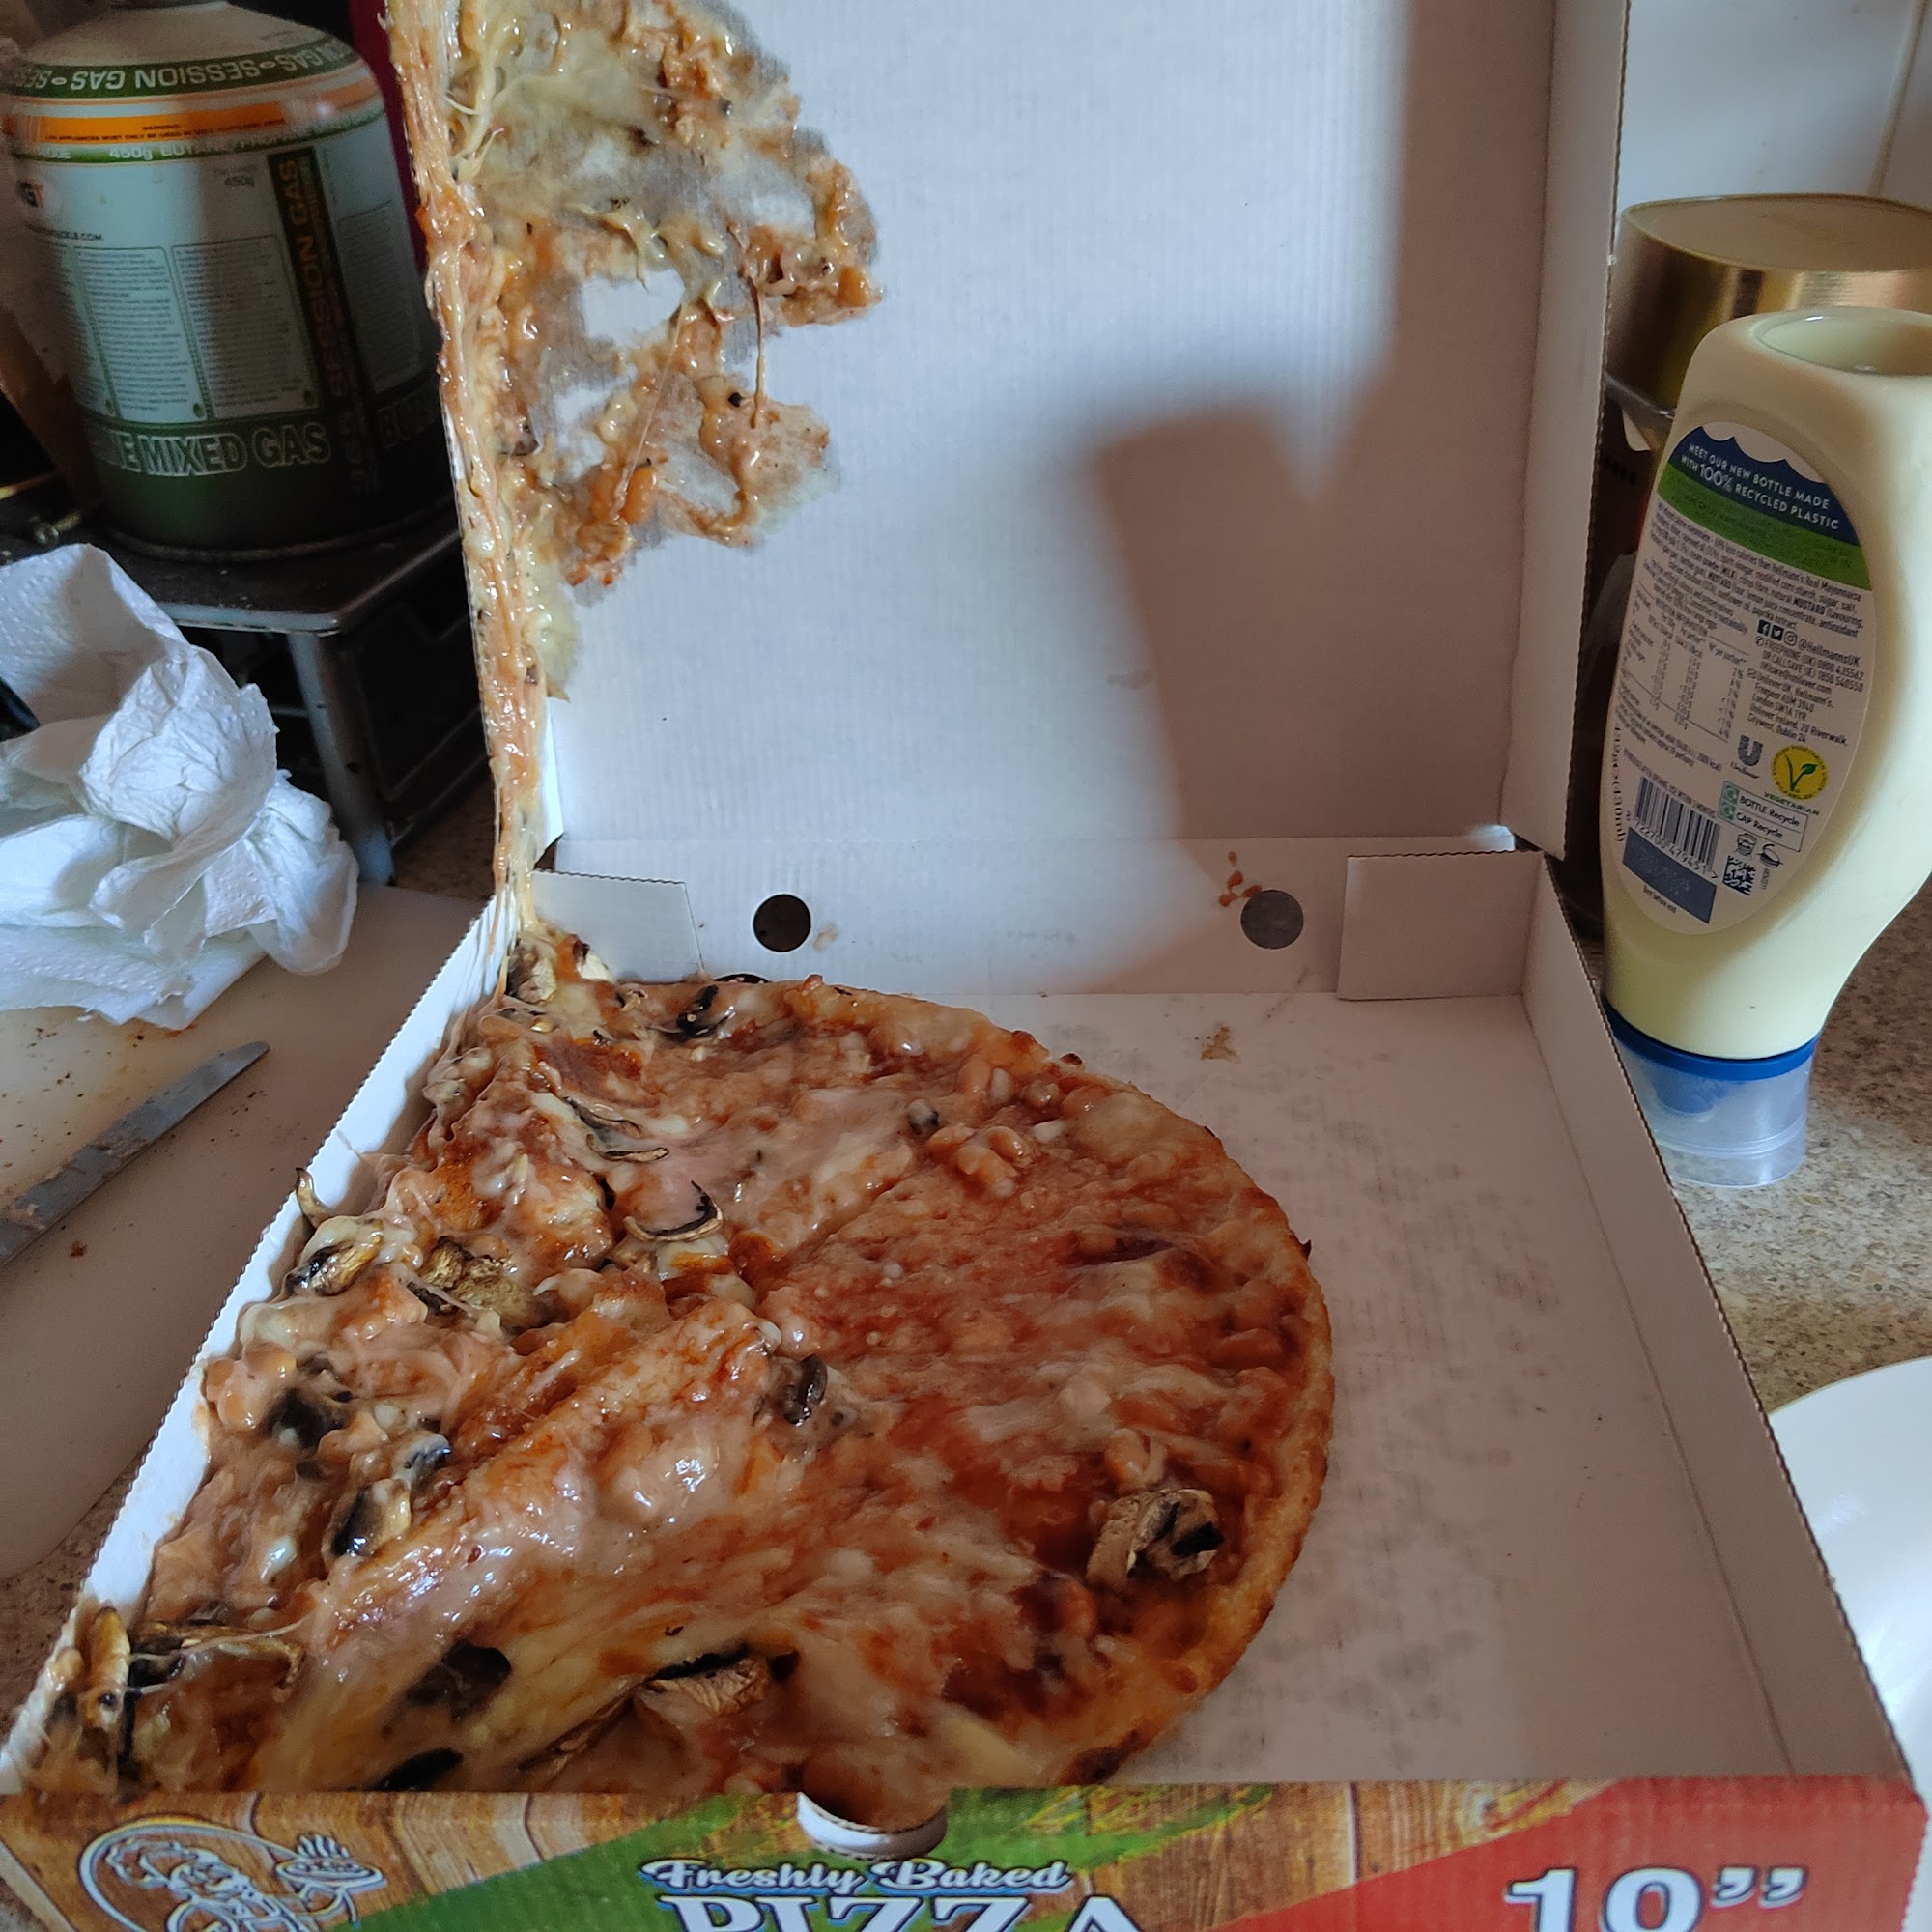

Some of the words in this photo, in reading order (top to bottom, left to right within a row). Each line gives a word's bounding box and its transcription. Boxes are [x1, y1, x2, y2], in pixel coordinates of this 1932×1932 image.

[70, 70, 126, 91] GAS
[134, 59, 261, 89] SESSION
[138, 432, 249, 477] MIXED
[252, 421, 331, 466] GAS
[1681, 454, 1698, 472] WITH
[1700, 462, 1732, 493] 100%
[1735, 483, 1787, 512] RECYCLED
[1791, 504, 1839, 529] PLASTIC
[1689, 443, 1708, 461] MEET
[1709, 452, 1727, 469] OUR
[1729, 463, 1750, 481] NEW
[1752, 473, 1791, 497] BOTTLE
[1794, 489, 1830, 510] MADE
[1799, 639, 1860, 667] @HellmannsUK
[1739, 796, 1767, 813] BOTTLE
[1770, 809, 1800, 827] Recycle
[1765, 792, 1820, 815] VEGETARIAN
[1737, 812, 1751, 824] CAP
[1753, 820, 1783, 838] Recycle
[639, 1857, 867, 1895] Freshly
[869, 1857, 1073, 1894] Baked
